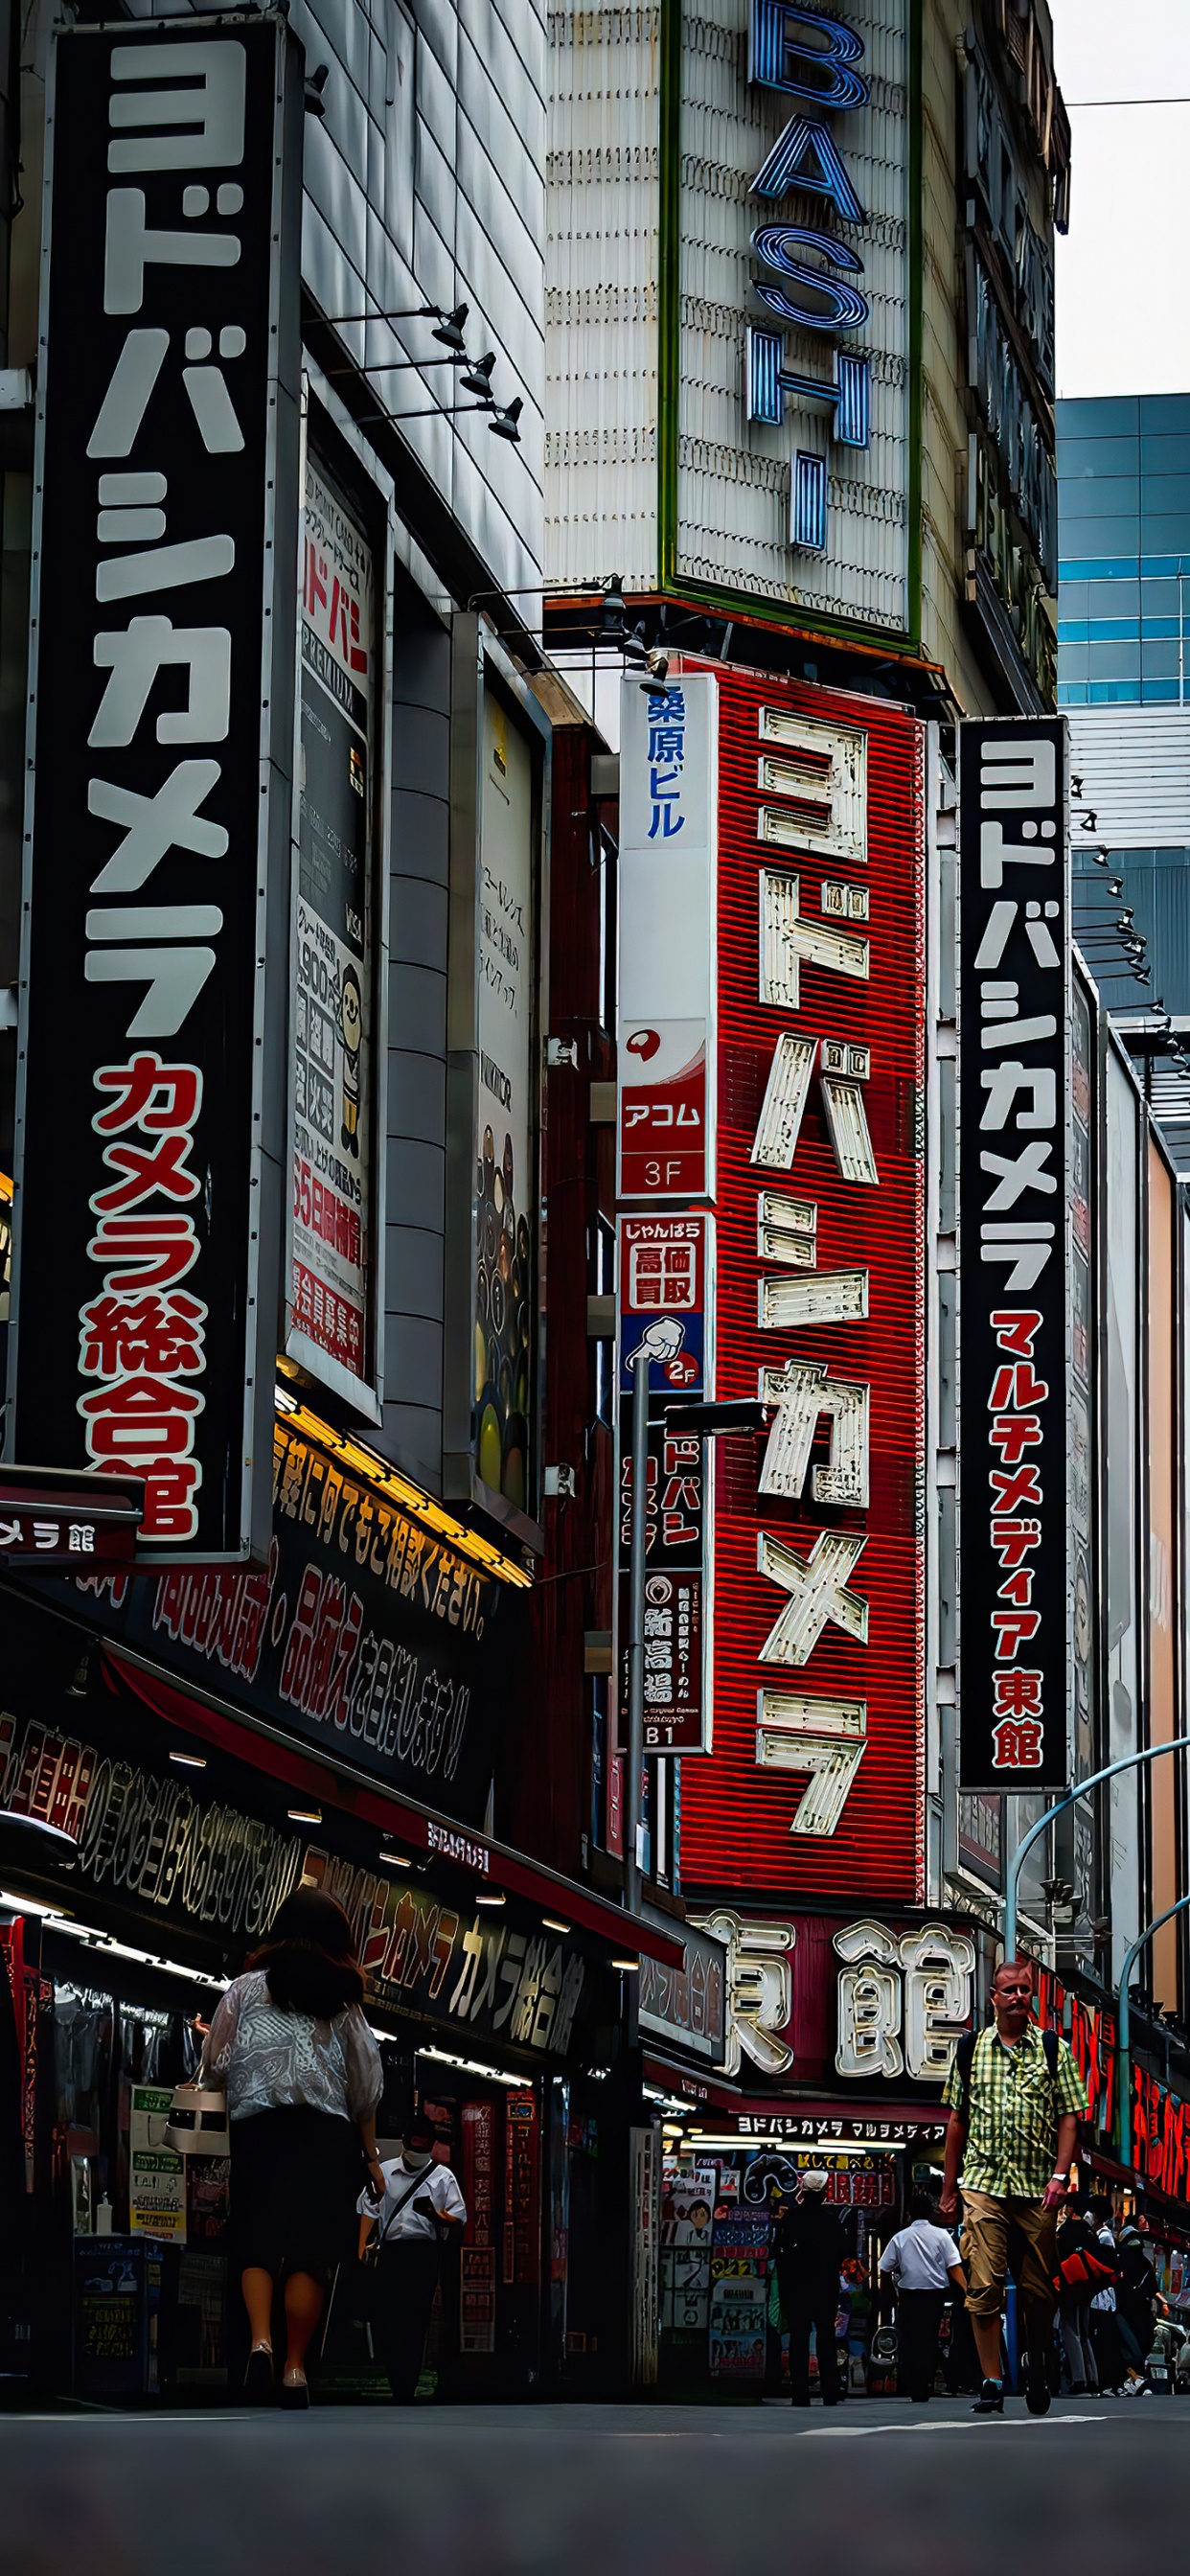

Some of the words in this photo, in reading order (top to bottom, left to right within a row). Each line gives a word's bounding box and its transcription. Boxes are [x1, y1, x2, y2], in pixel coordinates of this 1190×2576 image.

[84, 39, 247, 1038] ヨドバシカメラ
[304, 533, 367, 675] ドバシ
[647, 685, 686, 840] 桑原ビル
[973, 739, 1061, 1292] ヨドバシカメラ
[625, 1103, 701, 1128] アコム
[644, 1161, 682, 1186] 3F
[76, 1050, 207, 1543] カメラ総合館
[635, 1245, 692, 1275] 高価
[635, 1276, 692, 1306] 買取
[750, 704, 879, 1836] ヨドバシカメラ
[668, 1359, 697, 1384] 2F
[0, 1520, 95, 1552] メラ館
[987, 1309, 1050, 1660] マルチメディア
[646, 1726, 674, 1745] B1
[991, 1668, 1044, 1770] 東館
[447, 1913, 586, 2056] カメラ総合館
[684, 1908, 976, 2081] 東館
[737, 2116, 843, 2137] ヨドバシカメラ
